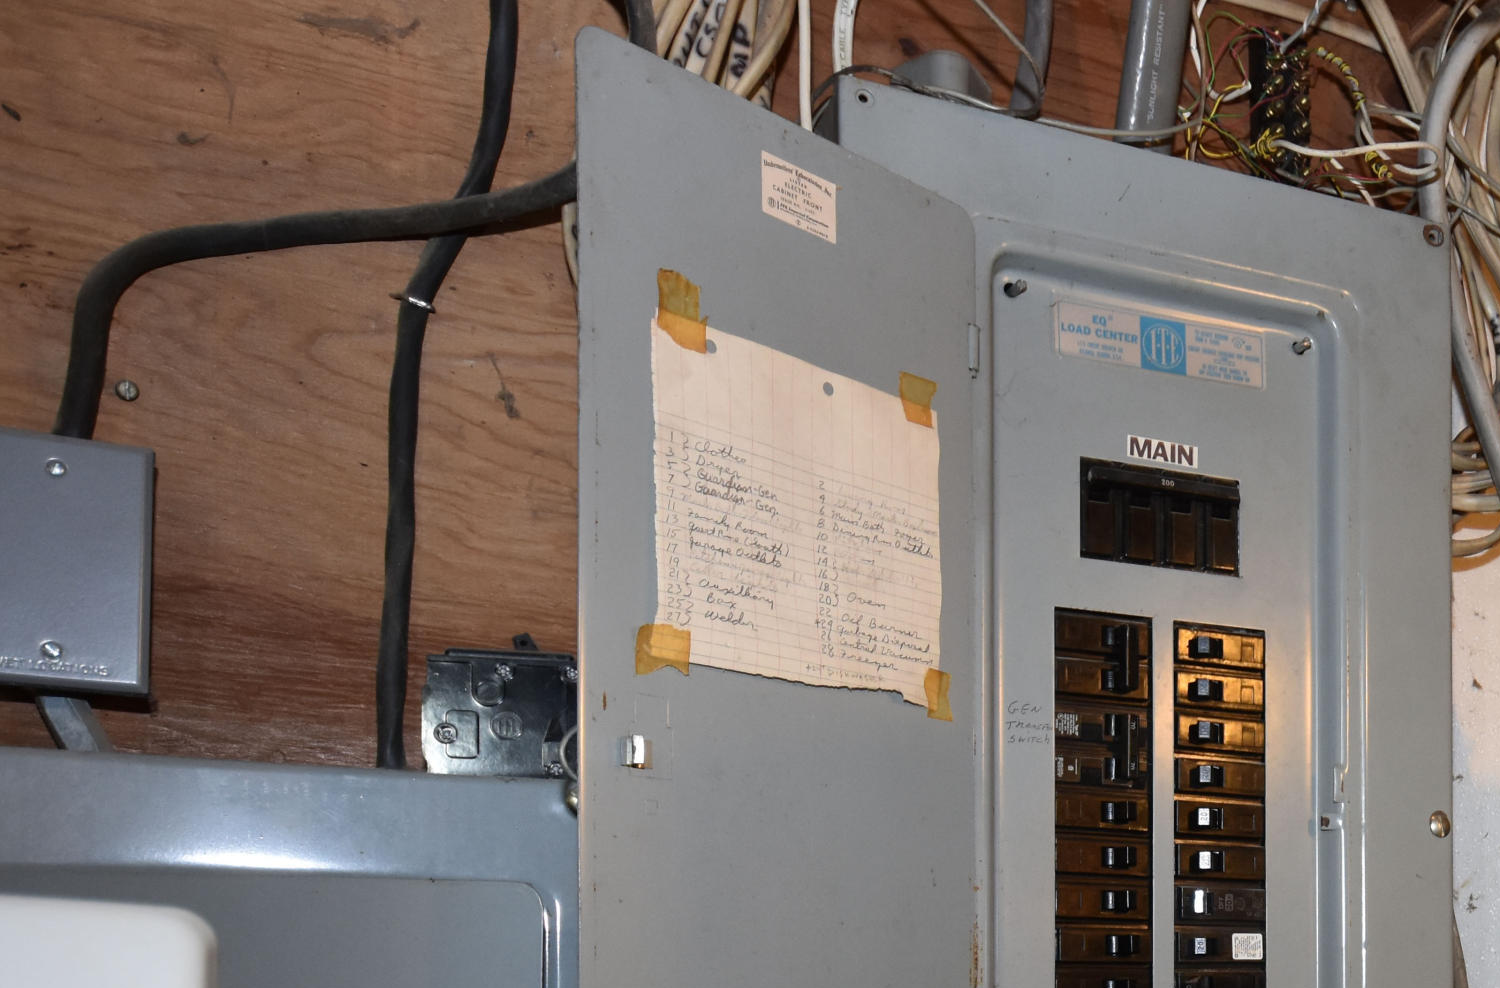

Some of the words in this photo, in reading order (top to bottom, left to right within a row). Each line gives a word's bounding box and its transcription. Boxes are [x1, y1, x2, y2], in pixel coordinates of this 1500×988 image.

[1061, 322, 1091, 336] LOAD
[1095, 328, 1138, 345] CENTER
[1129, 436, 1194, 467] MAIN
